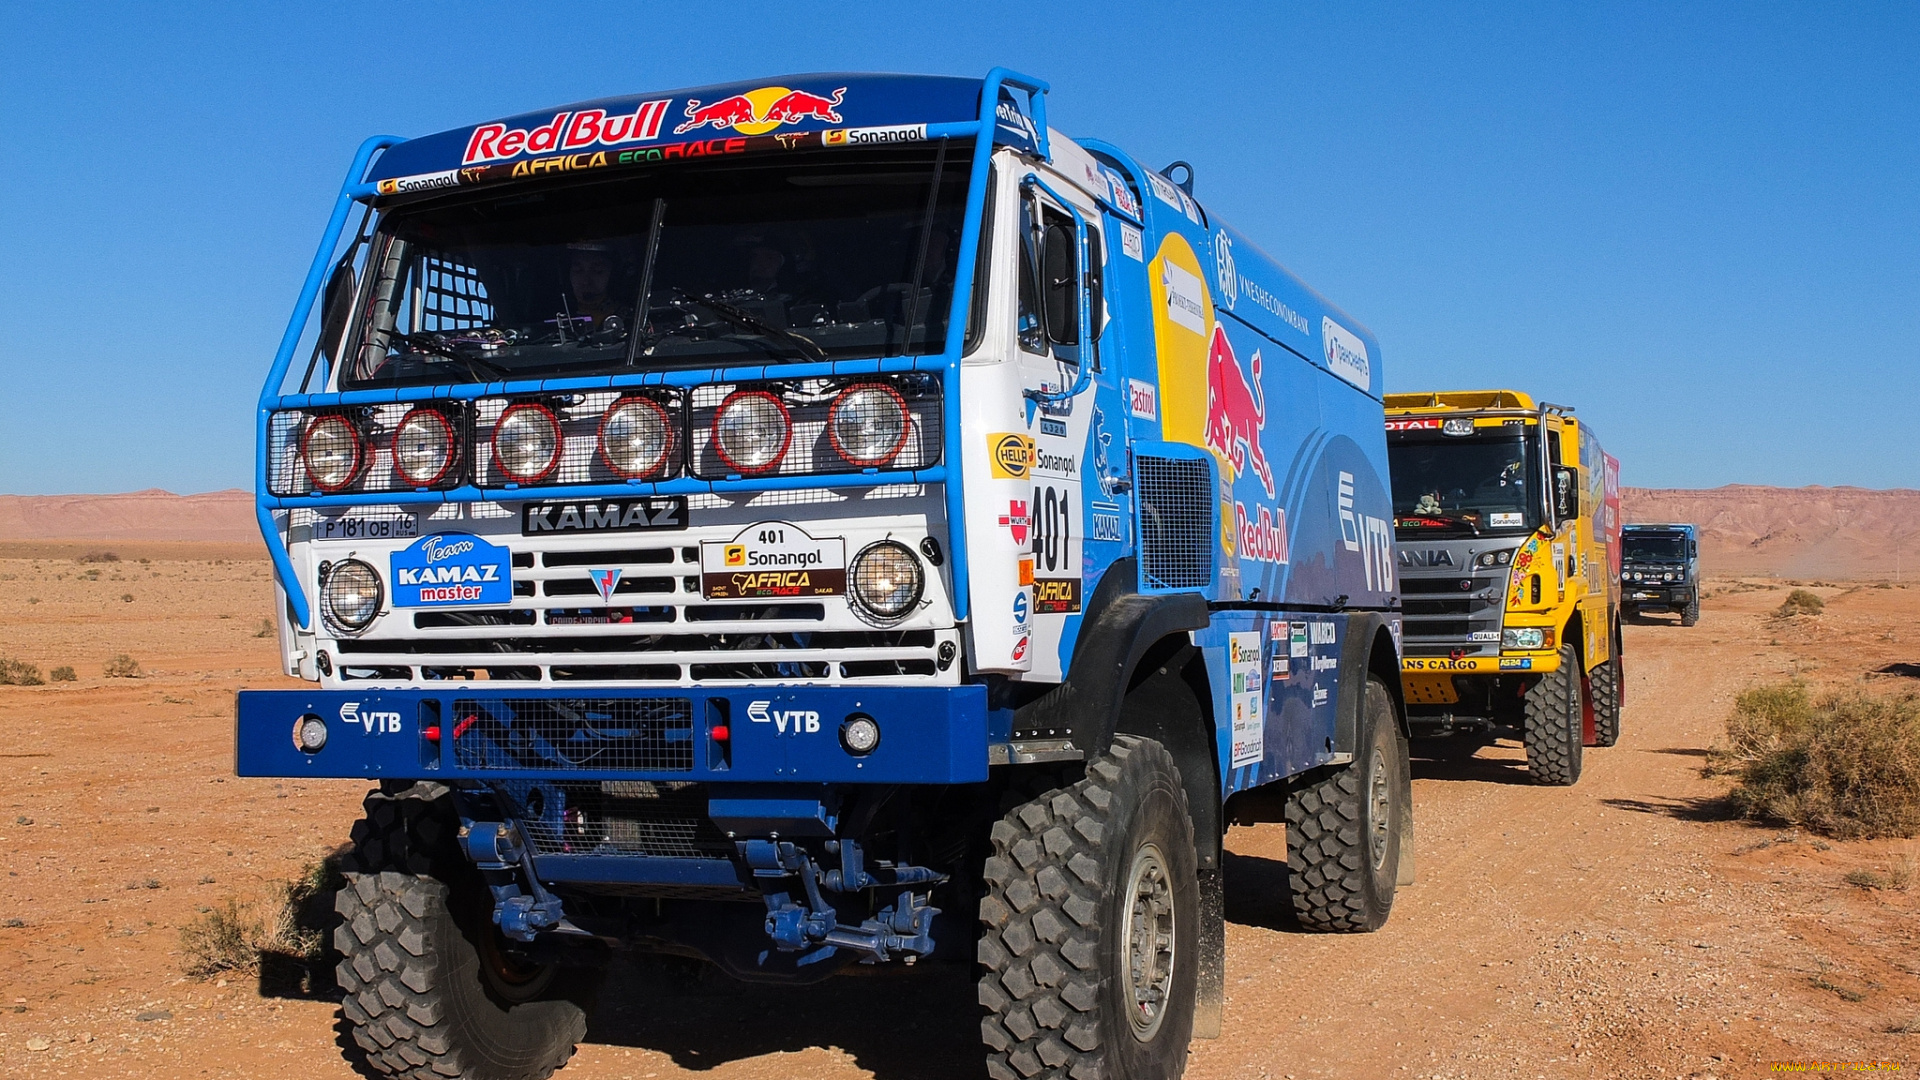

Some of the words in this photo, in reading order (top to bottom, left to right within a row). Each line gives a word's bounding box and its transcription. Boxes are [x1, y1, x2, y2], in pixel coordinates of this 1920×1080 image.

[464, 112, 569, 163] Red
[564, 100, 671, 149] Bull
[849, 126, 925, 143] Sonangol
[511, 151, 608, 178] AFRICA
[398, 172, 458, 193] Sonangol
[1238, 273, 1310, 336] VNESHECONOMBANK
[1385, 420, 1437, 430] OTAL
[1000, 450, 1027, 464] HELLA
[1037, 449, 1076, 477] Sonangol
[528, 500, 679, 532] KAMAZ
[759, 530, 784, 544] 401
[1032, 486, 1070, 572] 401
[1236, 501, 1263, 561] Red
[1262, 506, 1289, 565] Bull
[423, 536, 474, 564] Team
[748, 549, 822, 568] Sonangol
[1358, 513, 1393, 592] VTB
[398, 565, 500, 585] KAMAZ
[743, 572, 811, 588] AFRICA
[420, 585, 482, 601] master
[1039, 582, 1072, 600] AFRICA
[1238, 645, 1261, 666] Sonangol
[1428, 661, 1477, 669] CARGO
[362, 712, 401, 733] VTB
[773, 711, 820, 733] VTB
